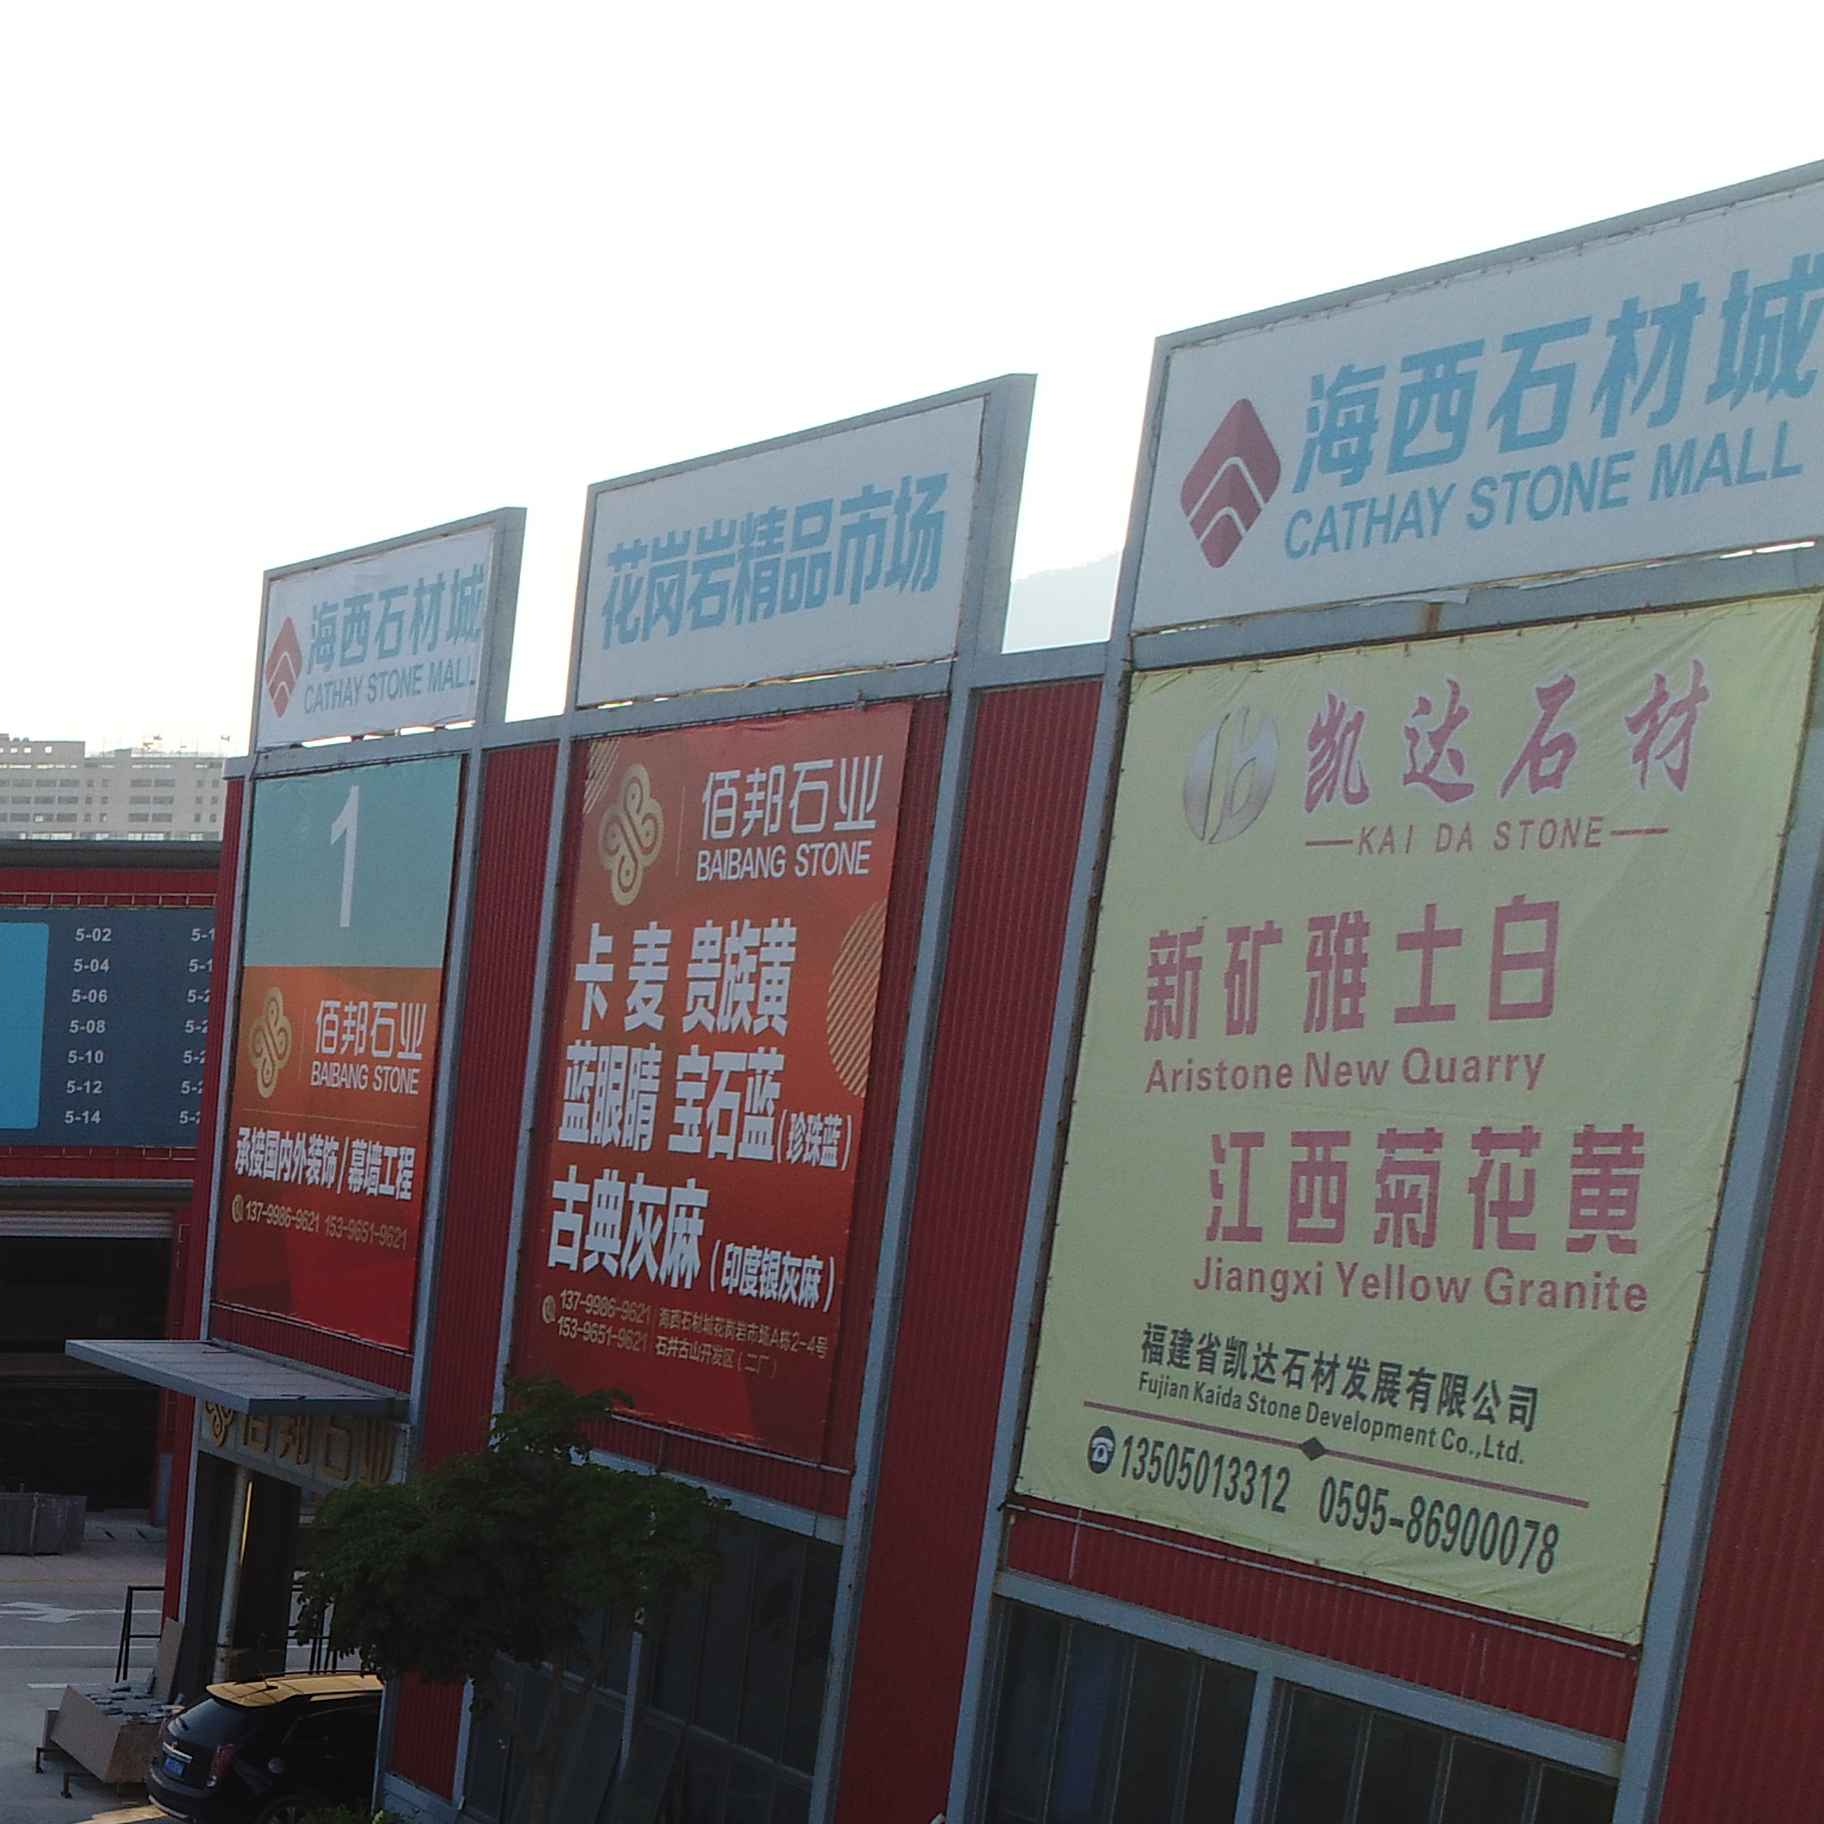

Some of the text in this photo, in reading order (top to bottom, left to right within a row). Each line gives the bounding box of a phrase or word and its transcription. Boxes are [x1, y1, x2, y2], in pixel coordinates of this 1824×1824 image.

[1292, 253, 1824, 494] 海西石材城
[1283, 420, 1804, 560] CATHAY STONE MALL
[601, 472, 949, 650] 花岗岩精品市场
[306, 563, 486, 675] 海西石材城
[304, 654, 477, 715] CATHAY STONE MALL
[1303, 657, 1712, 815] 凯达石材
[701, 754, 885, 841] 佰邦石业
[330, 784, 360, 929] 1
[696, 839, 873, 883] BAIBANG STONE
[1358, 815, 1605, 856] KAI DA STONE
[75, 927, 112, 944] 5-02
[191, 928, 215, 942] 5-1
[73, 957, 110, 974] 5-04
[188, 959, 213, 973] 5-1
[574, 917, 798, 1038] 卡麦 贵族黄
[1144, 893, 1562, 1043] 新矿雅士白
[71, 988, 108, 1005] 5-06
[187, 989, 211, 1003] 5-2
[69, 1018, 106, 1035] 5-08
[184, 1020, 208, 1034] 5-2
[313, 999, 428, 1061] 佰邦石业
[67, 1049, 105, 1066] 5-10
[310, 1060, 421, 1096] BAIBANG STONE
[1146, 1045, 1547, 1095] Aristone New Quarry
[66, 1079, 103, 1096] 5-12
[558, 1038, 853, 1172] 蓝眼睛 宝石蓝 (珍珠蓝)
[64, 1109, 101, 1127] 5-14
[1205, 1123, 1647, 1256] 江西菊花黄
[245, 1199, 408, 1252] 137-9986-9621 153-9651-9621
[546, 1163, 835, 1313] 古典灰麻 (印度银灰麻)
[559, 1289, 653, 1324] 137-9986-9621
[1194, 1256, 1648, 1313] Jiangxi Yellow Granite
[556, 1313, 649, 1352] 153-9651-9621
[1140, 1321, 1540, 1435] 福建省凯达石材发展有限公司
[1138, 1370, 1526, 1467] Fujian Kaida Stone Development Co.,Ltd.
[1120, 1433, 1561, 1577] 13505013312 0595-86900078
